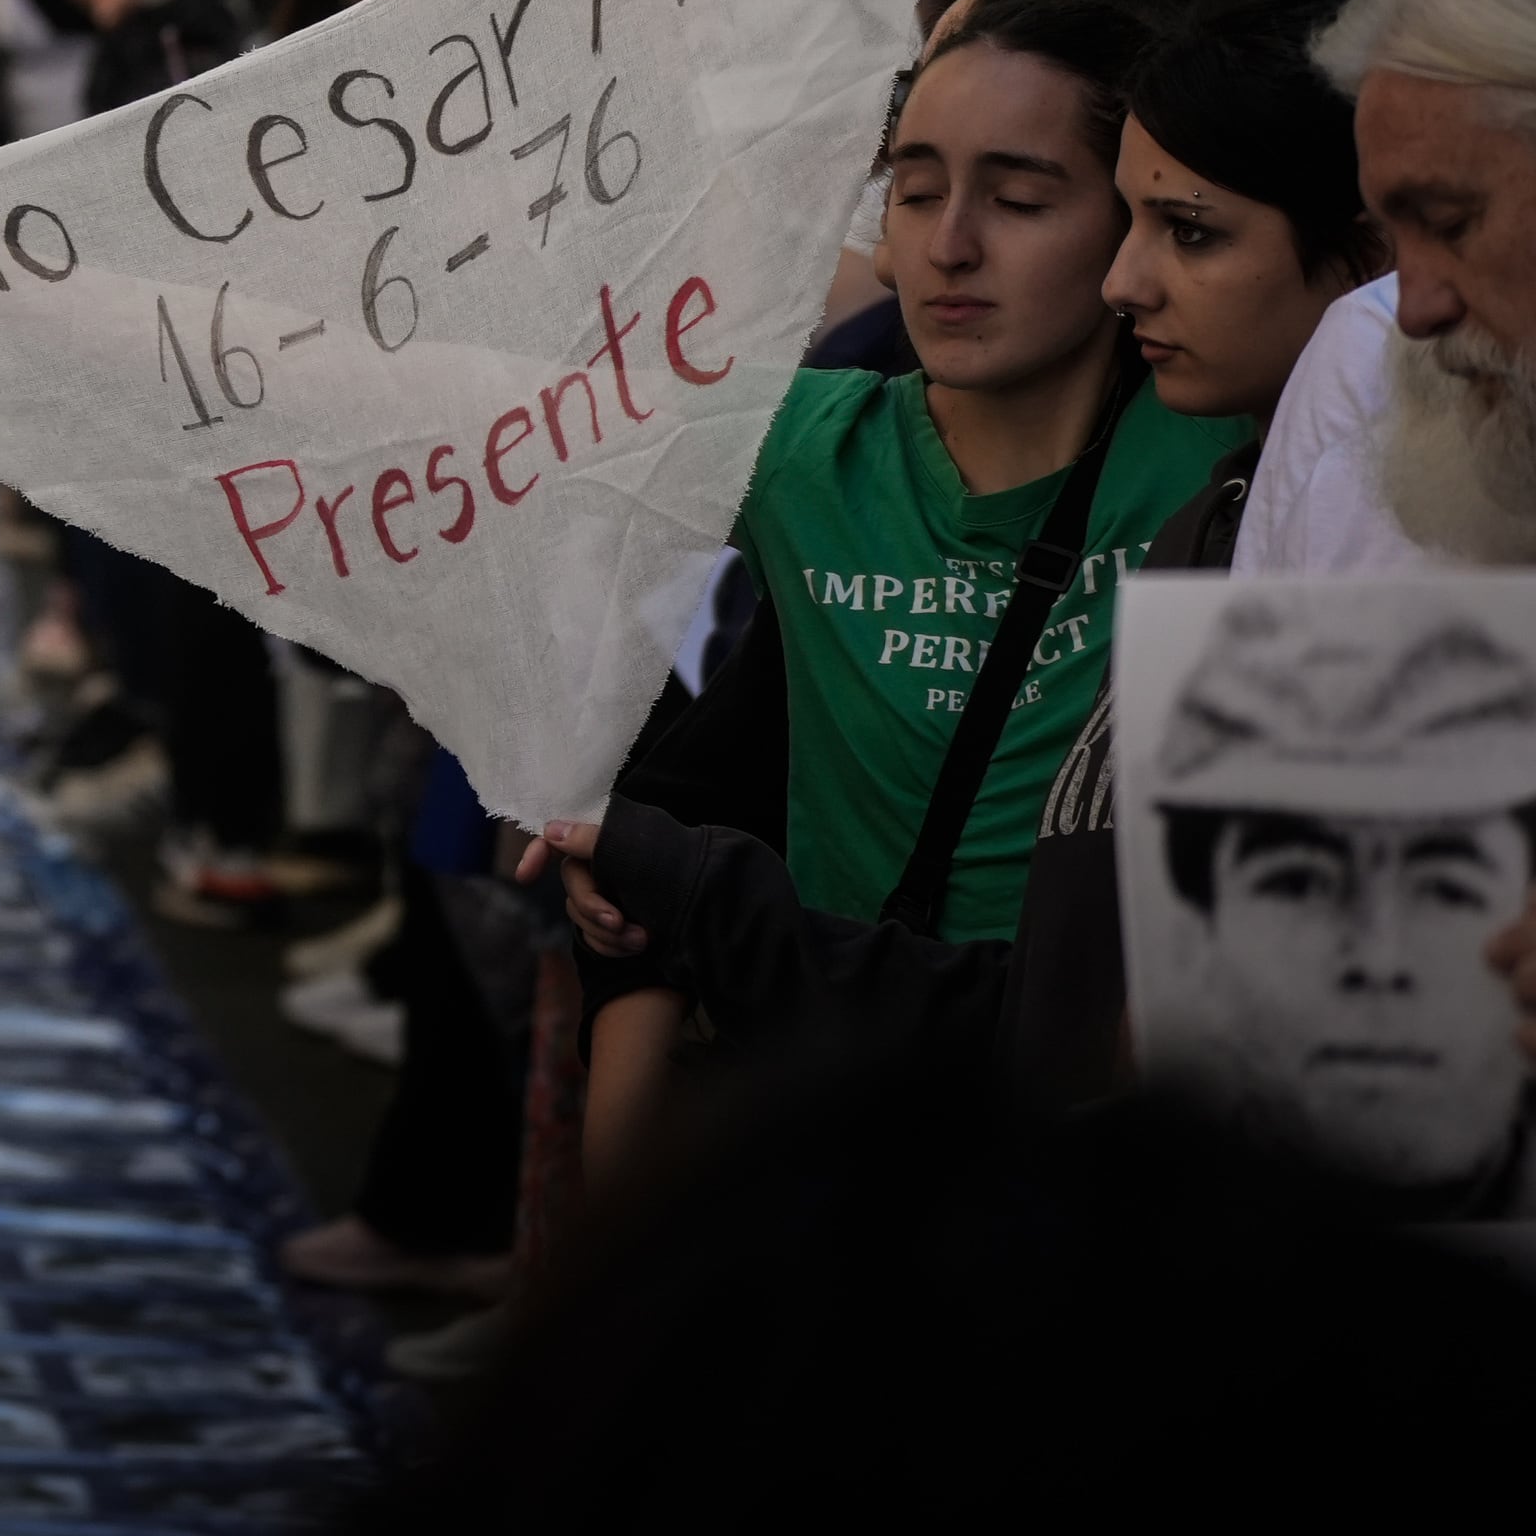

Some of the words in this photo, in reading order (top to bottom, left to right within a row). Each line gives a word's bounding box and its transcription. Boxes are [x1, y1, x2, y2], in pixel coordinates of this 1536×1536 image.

[215, 275, 735, 597] Presente
[940, 554, 1004, 581] ET'S
[926, 679, 1042, 712] PELE
